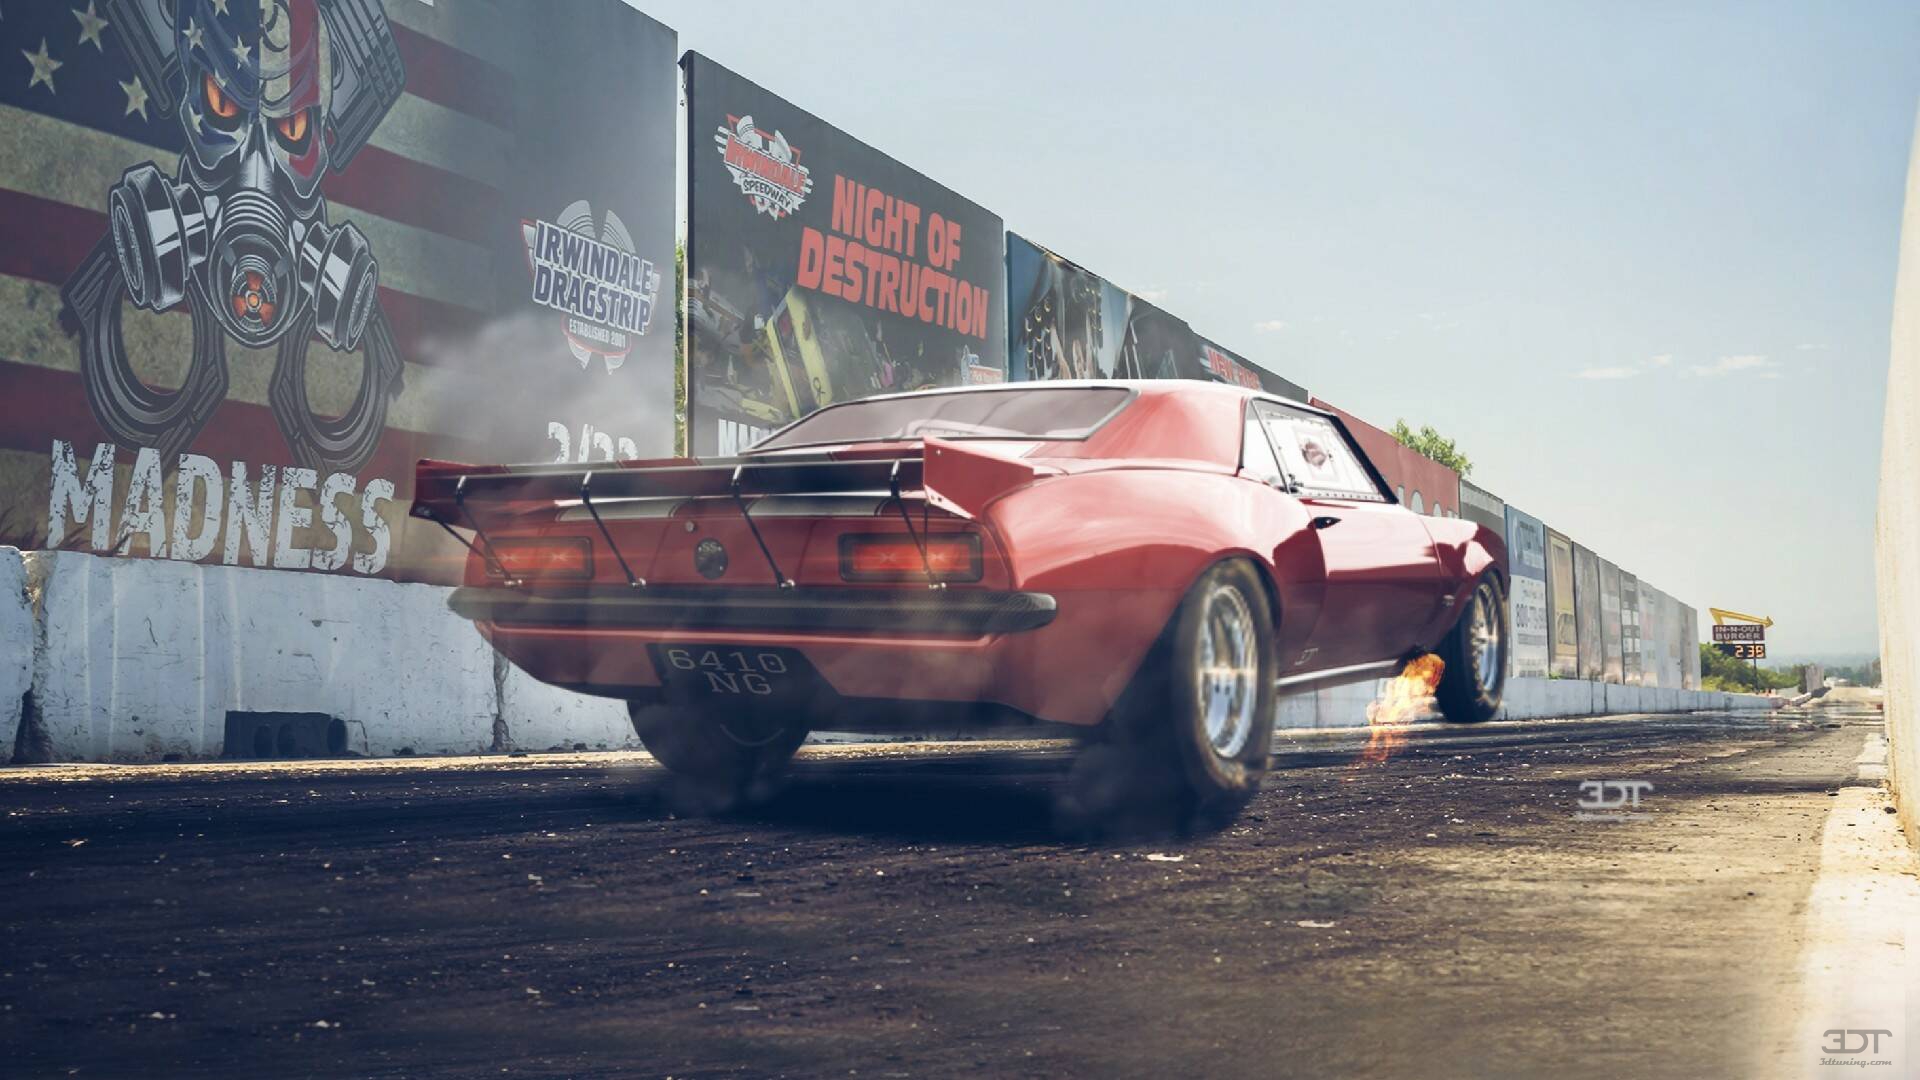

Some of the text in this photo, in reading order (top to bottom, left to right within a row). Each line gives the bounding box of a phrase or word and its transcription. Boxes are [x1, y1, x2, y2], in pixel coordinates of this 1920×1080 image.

[743, 178, 791, 209] SPEEDWAY
[832, 173, 962, 271] NIGHT OF
[535, 220, 654, 297] IRWINDALE
[797, 226, 990, 340] DESTRUCTION
[533, 261, 652, 335] DRAGSTRIP
[47, 439, 395, 575] MADNESS
[668, 649, 788, 674] 6410
[1715, 632, 1760, 640] BURGER
[704, 671, 772, 695] NG
